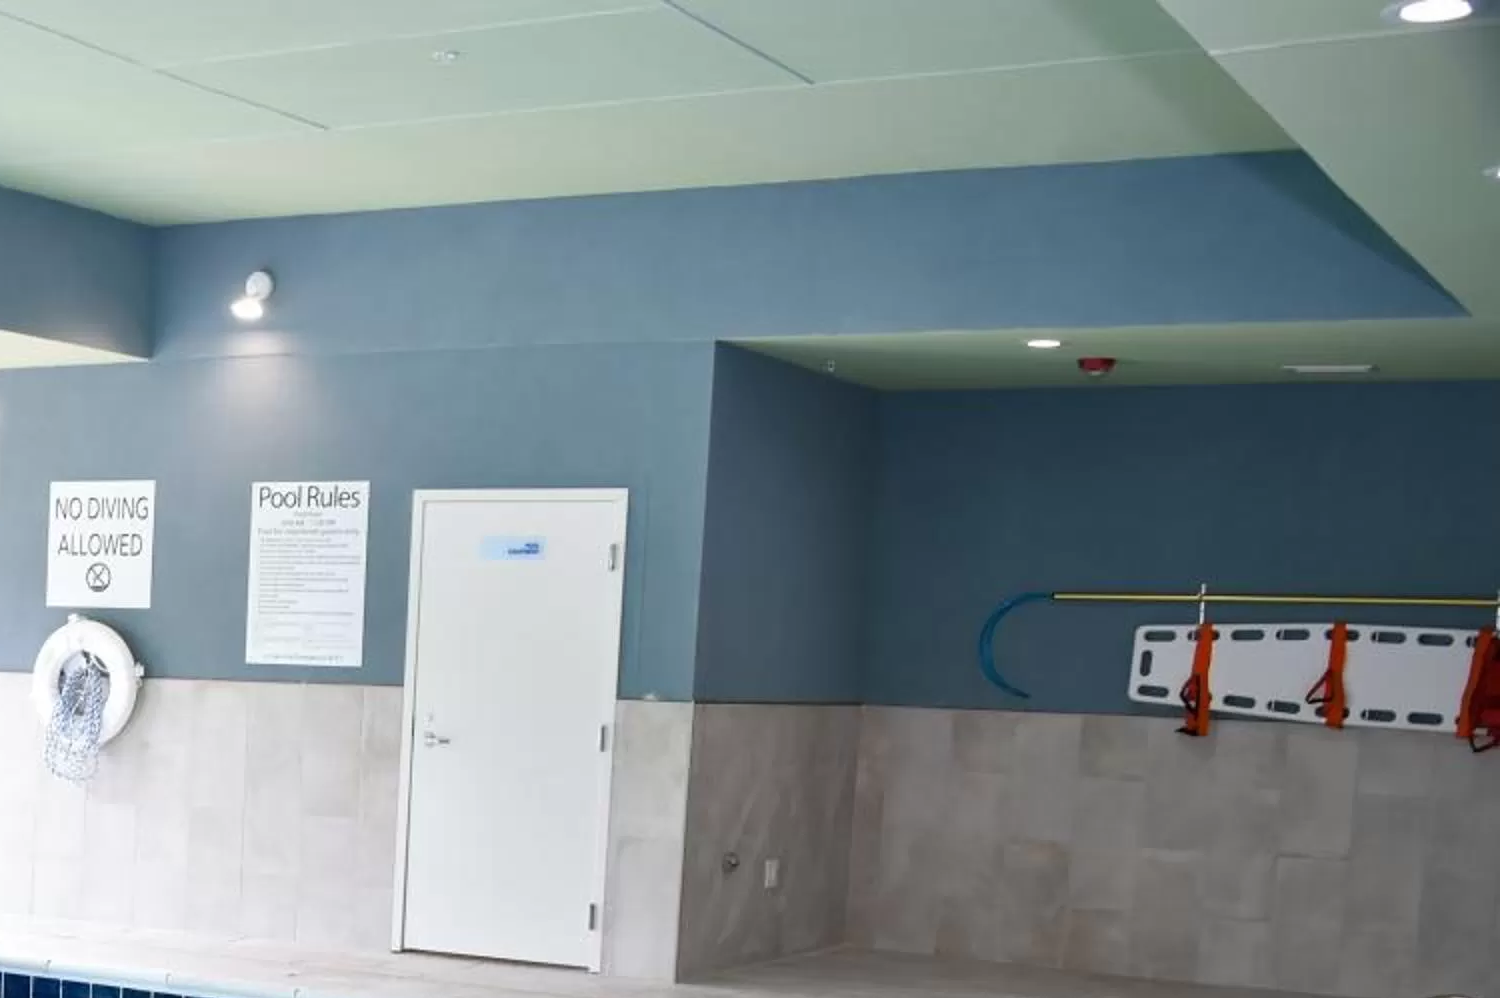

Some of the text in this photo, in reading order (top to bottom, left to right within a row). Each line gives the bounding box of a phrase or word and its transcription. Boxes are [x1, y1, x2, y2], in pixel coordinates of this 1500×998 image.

[55, 496, 149, 520] NO DIVING
[259, 485, 361, 508] Pool Rules
[57, 533, 143, 557] ALLOWED
